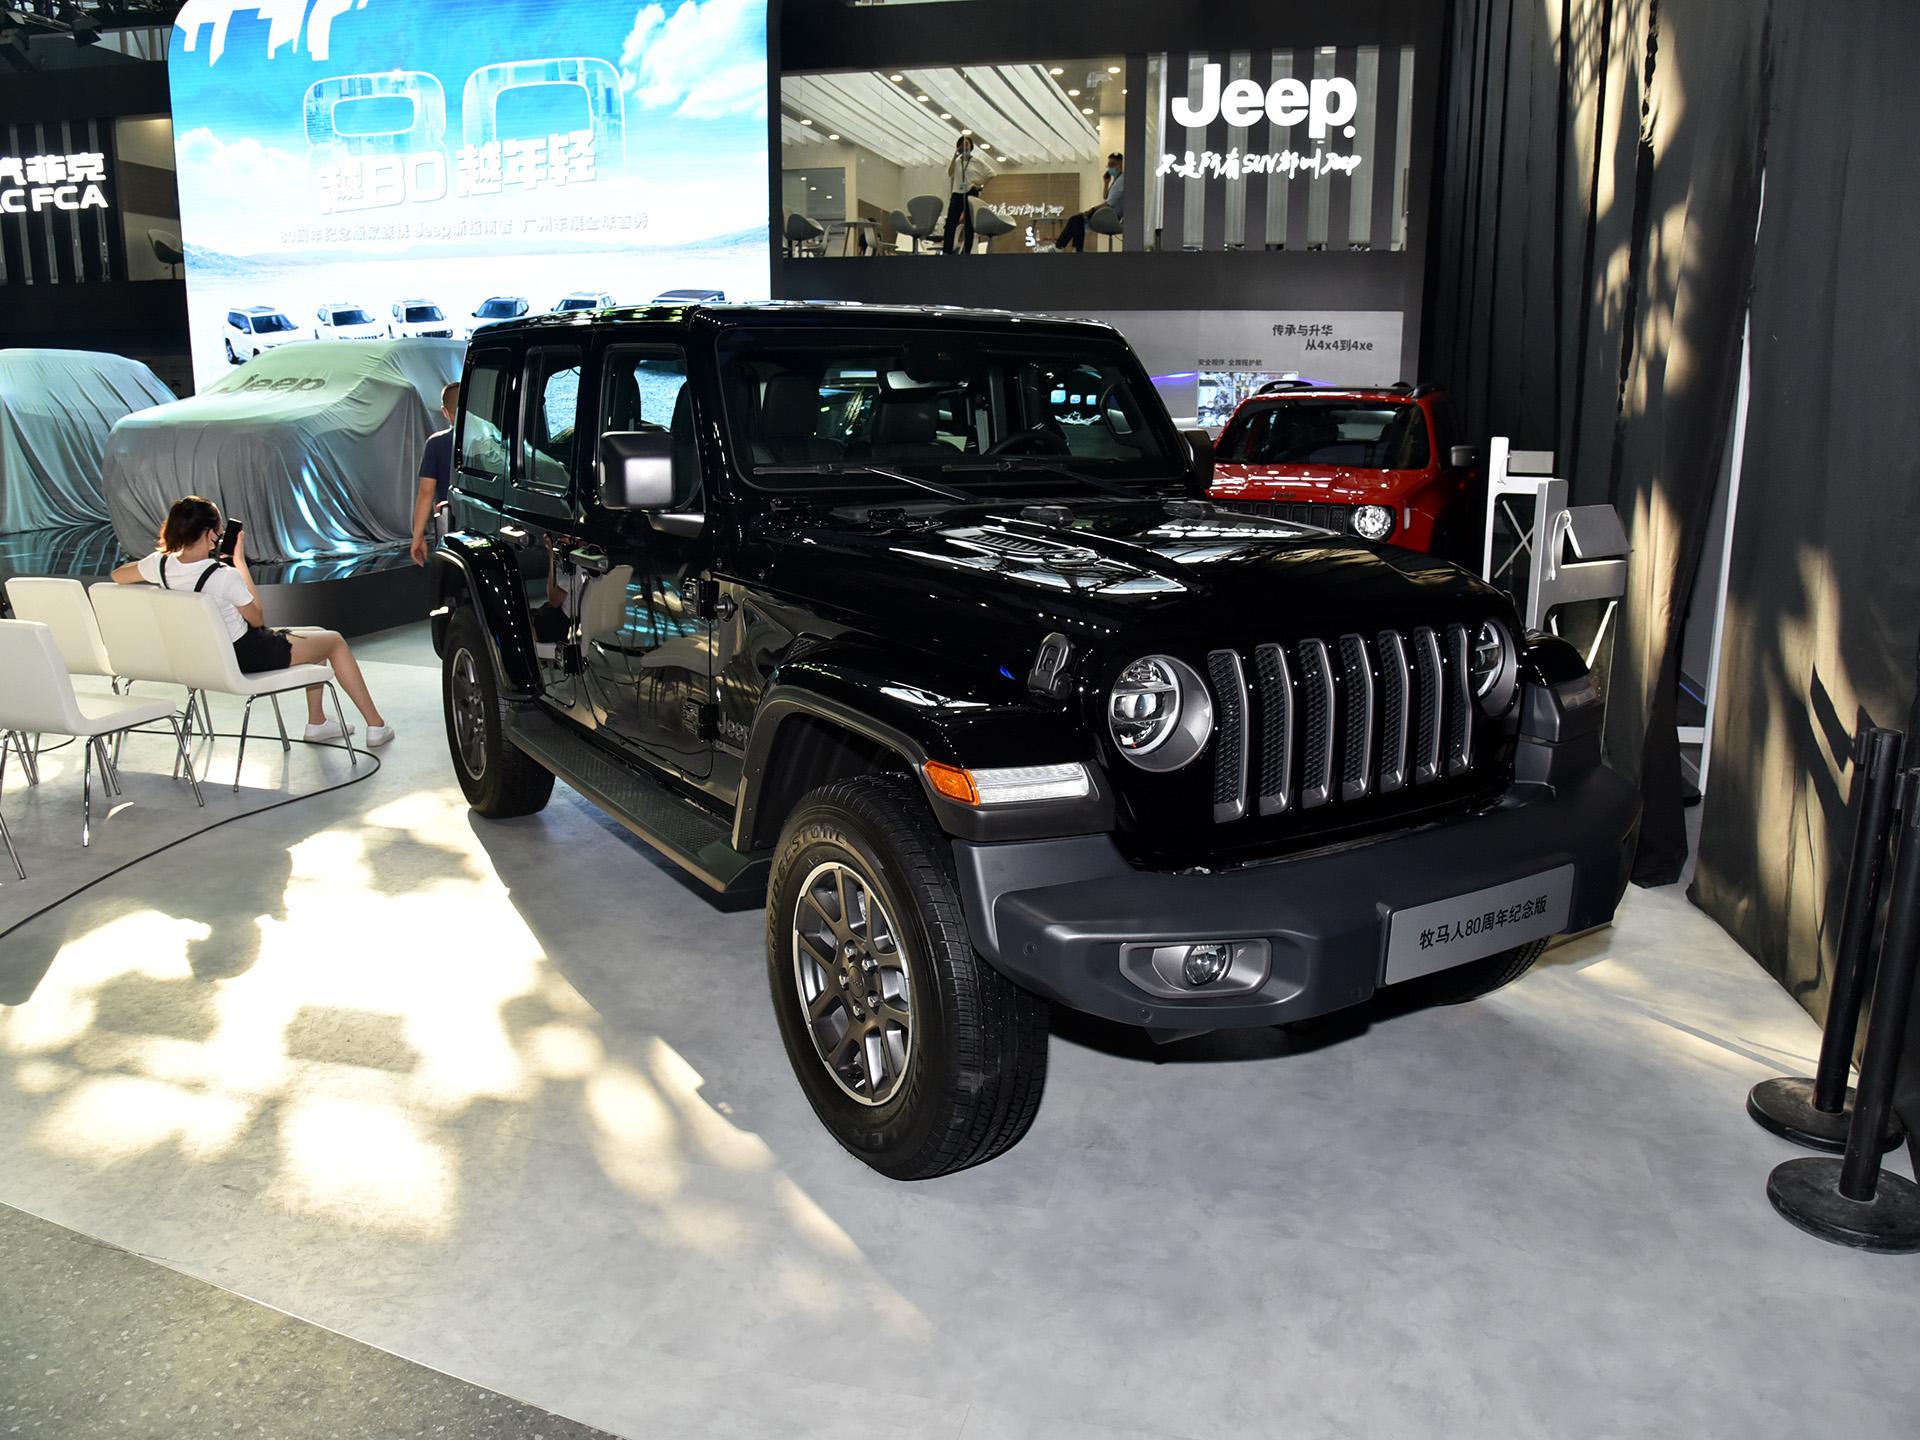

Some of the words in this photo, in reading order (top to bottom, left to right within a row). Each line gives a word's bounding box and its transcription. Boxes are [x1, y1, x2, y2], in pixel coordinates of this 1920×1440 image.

[0, 189, 27, 214] C
[31, 184, 109, 212] FCA
[1272, 323, 1333, 337] 传承与升华
[1304, 338, 1374, 352] 从4x4到4xe
[217, 373, 326, 393] Jeep
[1418, 894, 1548, 950] 牧马人80周年纪念版
